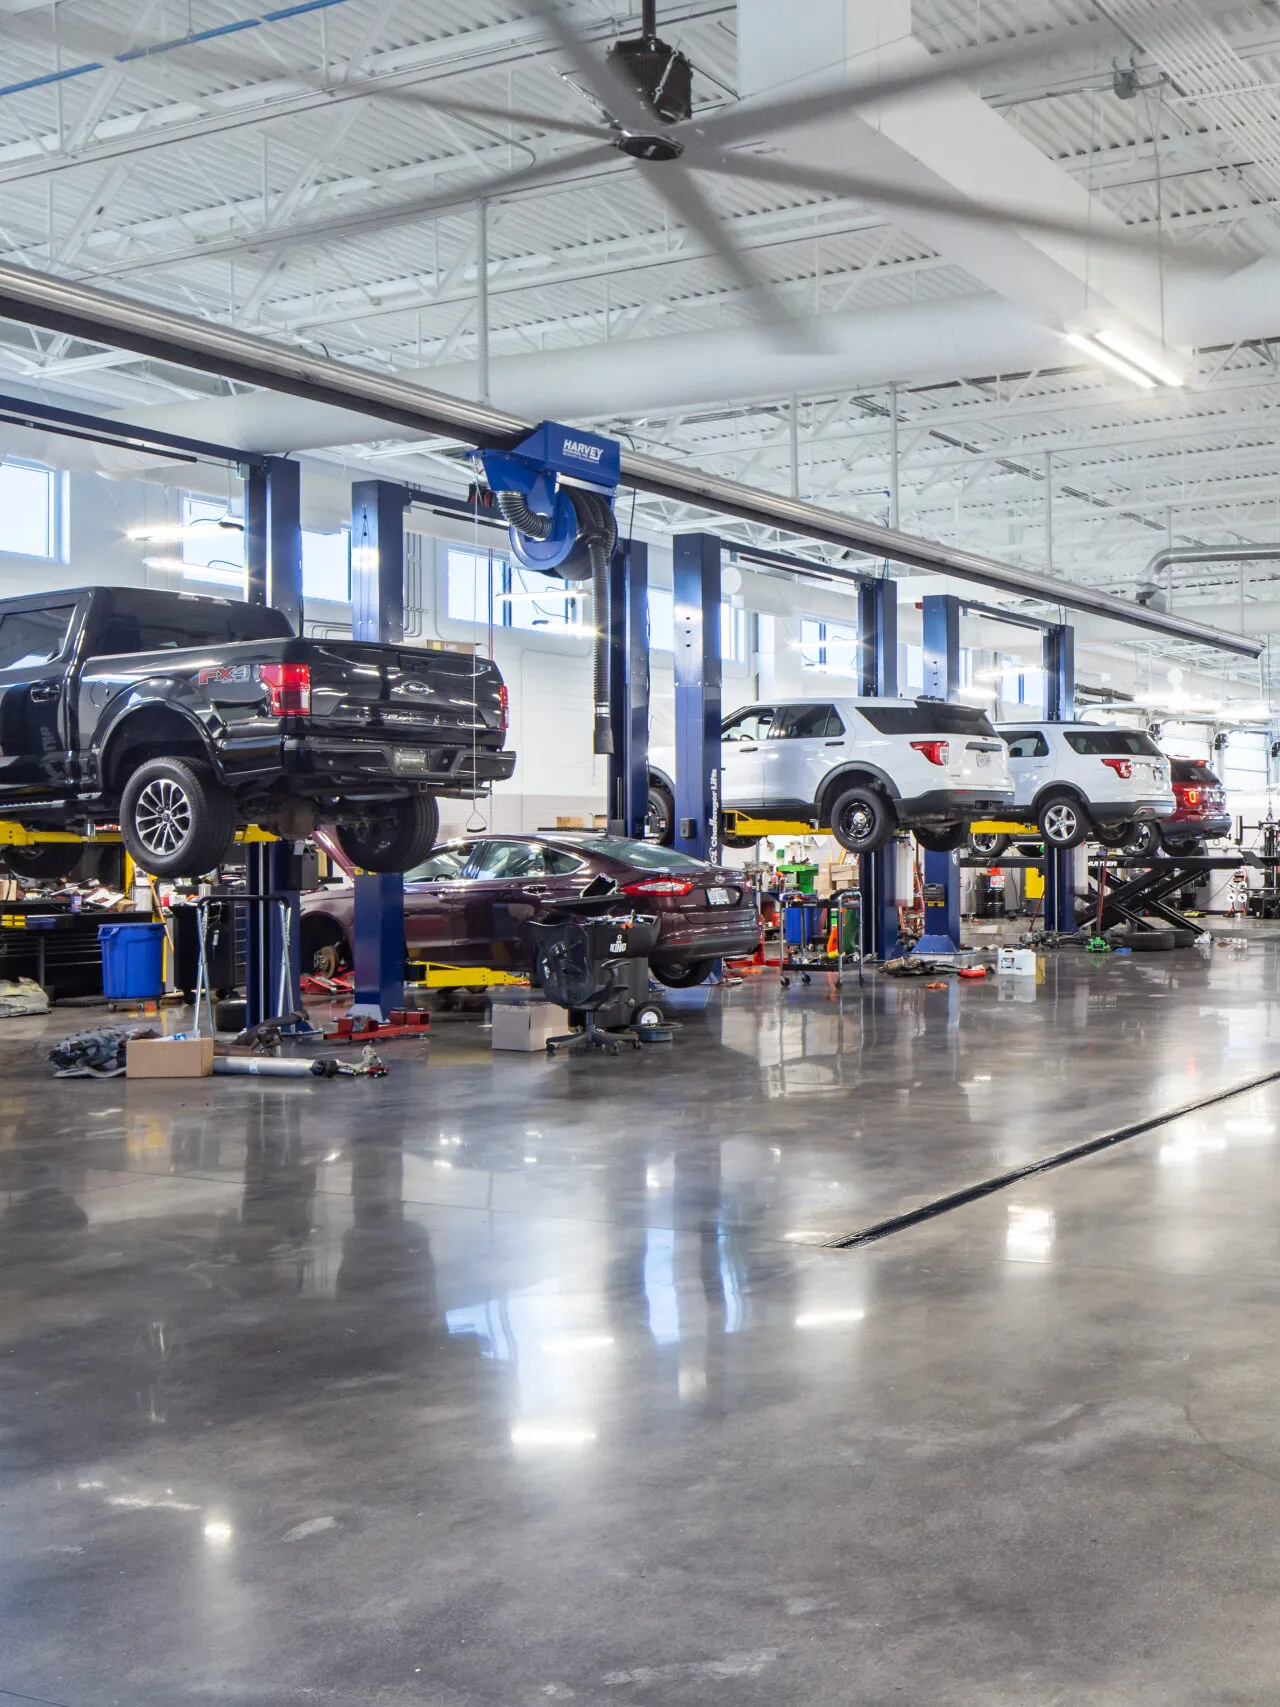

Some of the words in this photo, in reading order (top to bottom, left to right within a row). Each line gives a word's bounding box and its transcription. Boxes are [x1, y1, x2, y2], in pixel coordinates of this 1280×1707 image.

[563, 439, 604, 460] HARVEY
[199, 665, 250, 685] FX4
[710, 768, 718, 790] Lifts
[708, 791, 719, 847] Challenger
[610, 943, 627, 952] KING
